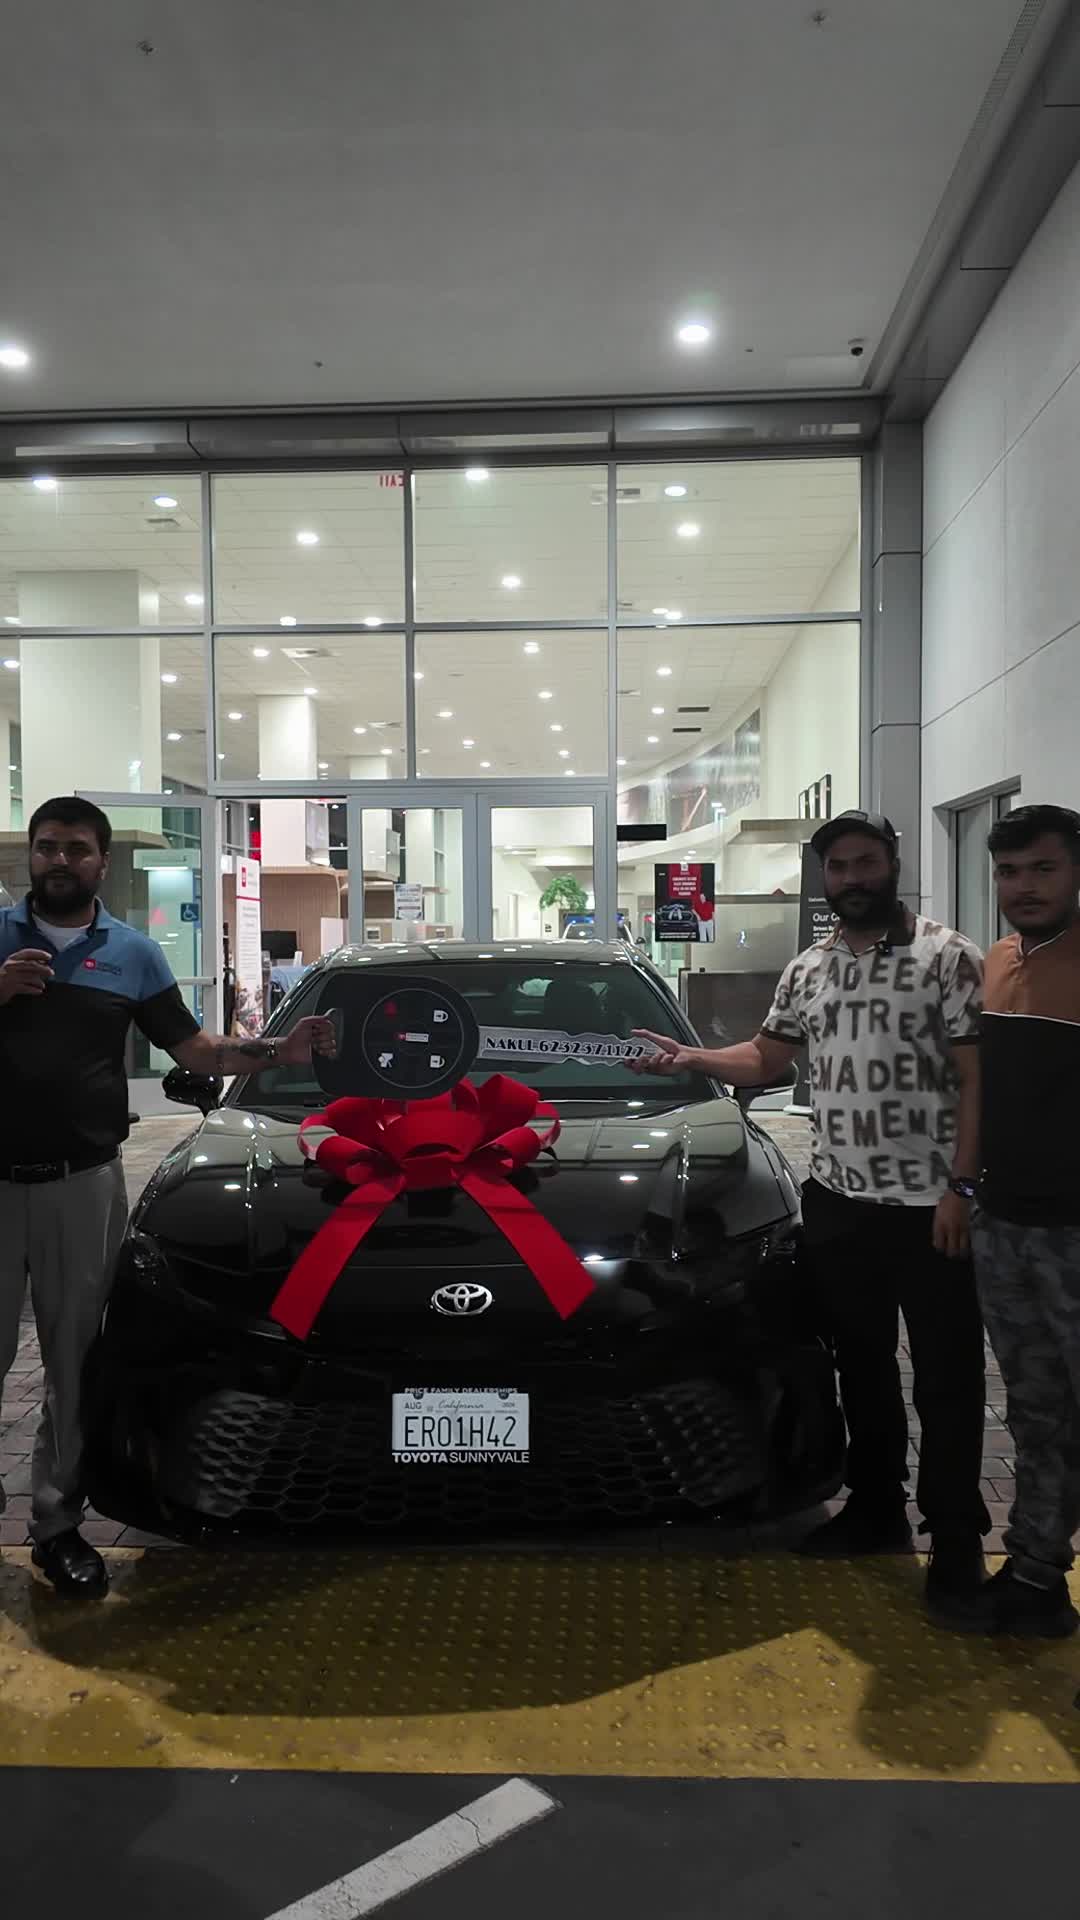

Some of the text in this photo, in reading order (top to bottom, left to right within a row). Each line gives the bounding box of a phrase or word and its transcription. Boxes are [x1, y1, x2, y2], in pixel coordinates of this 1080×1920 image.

[812, 912, 830, 922] Our
[485, 1036, 535, 1052] NAKUL
[404, 1401, 422, 1410] AUG
[438, 1399, 485, 1414] California
[404, 1415, 517, 1448] ER01H42
[392, 1451, 530, 1464] TOYOTA SUNNYVALE
